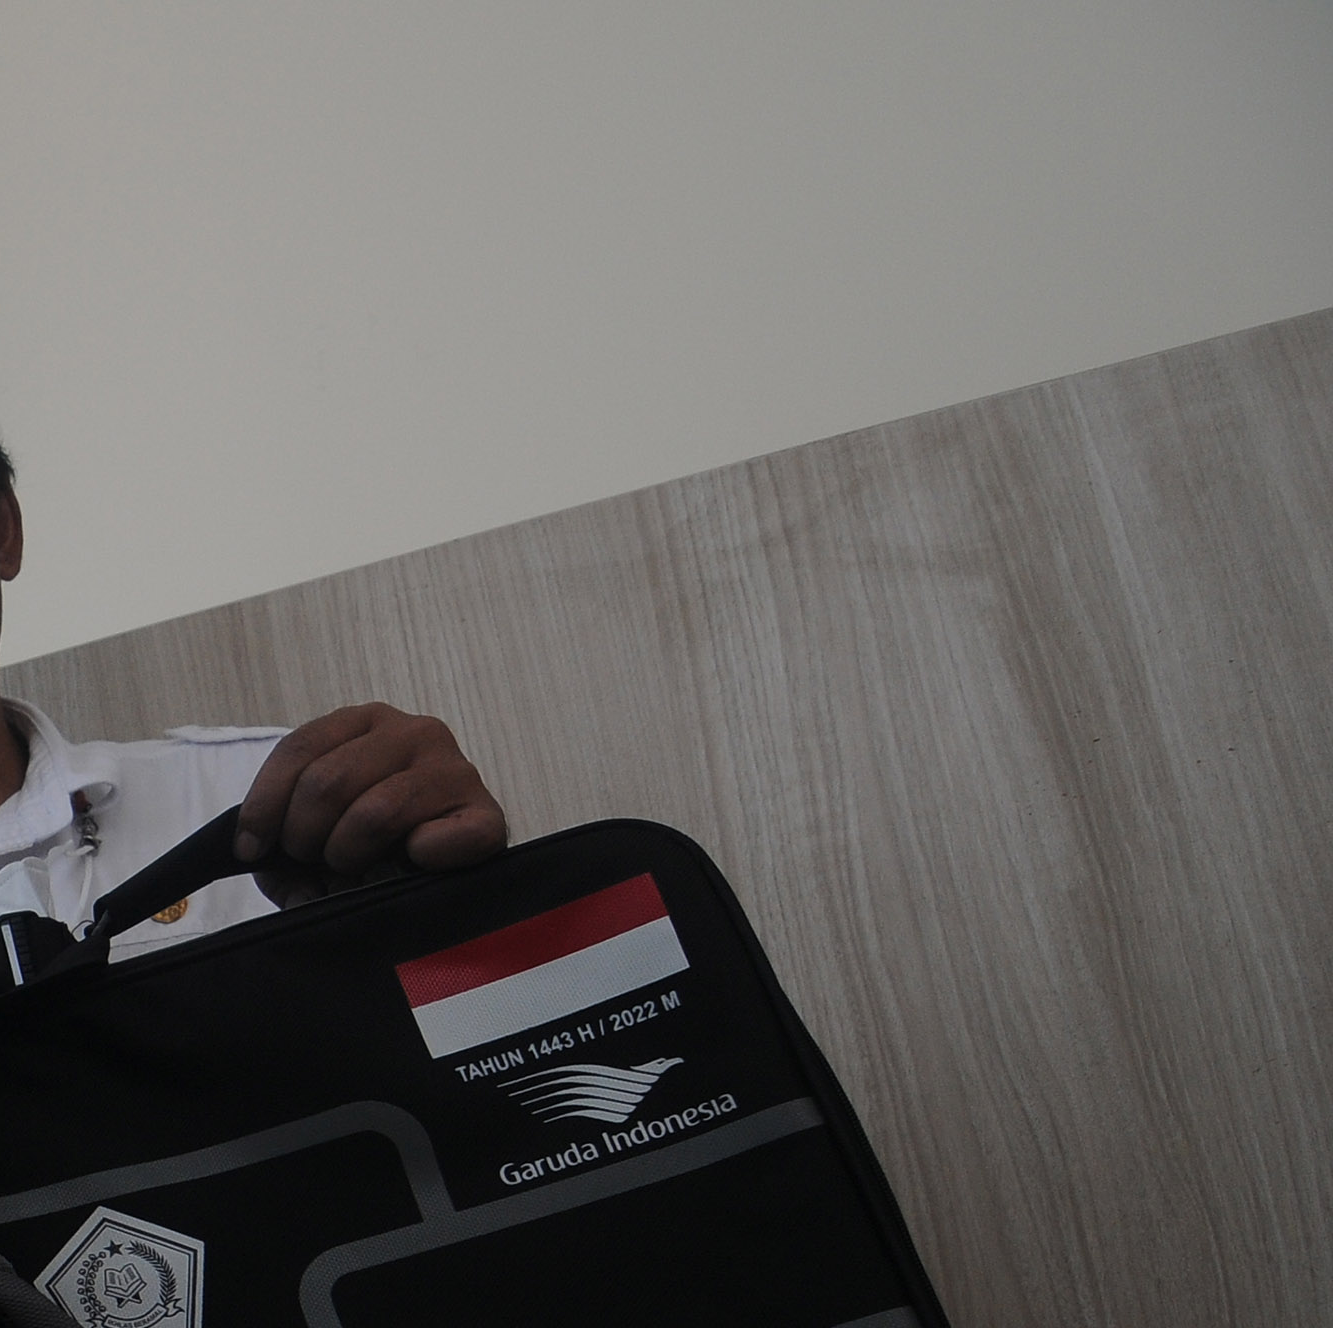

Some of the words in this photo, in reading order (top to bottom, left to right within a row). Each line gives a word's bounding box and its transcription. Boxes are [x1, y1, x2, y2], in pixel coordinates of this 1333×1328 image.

[454, 1049, 525, 1083] TAHUN
[528, 1030, 575, 1060] 1443
[576, 1022, 595, 1043] H
[609, 1000, 658, 1033] 2022
[661, 989, 682, 1010] M
[498, 1142, 599, 1186] Garuda
[602, 1091, 739, 1155] Indonesia
